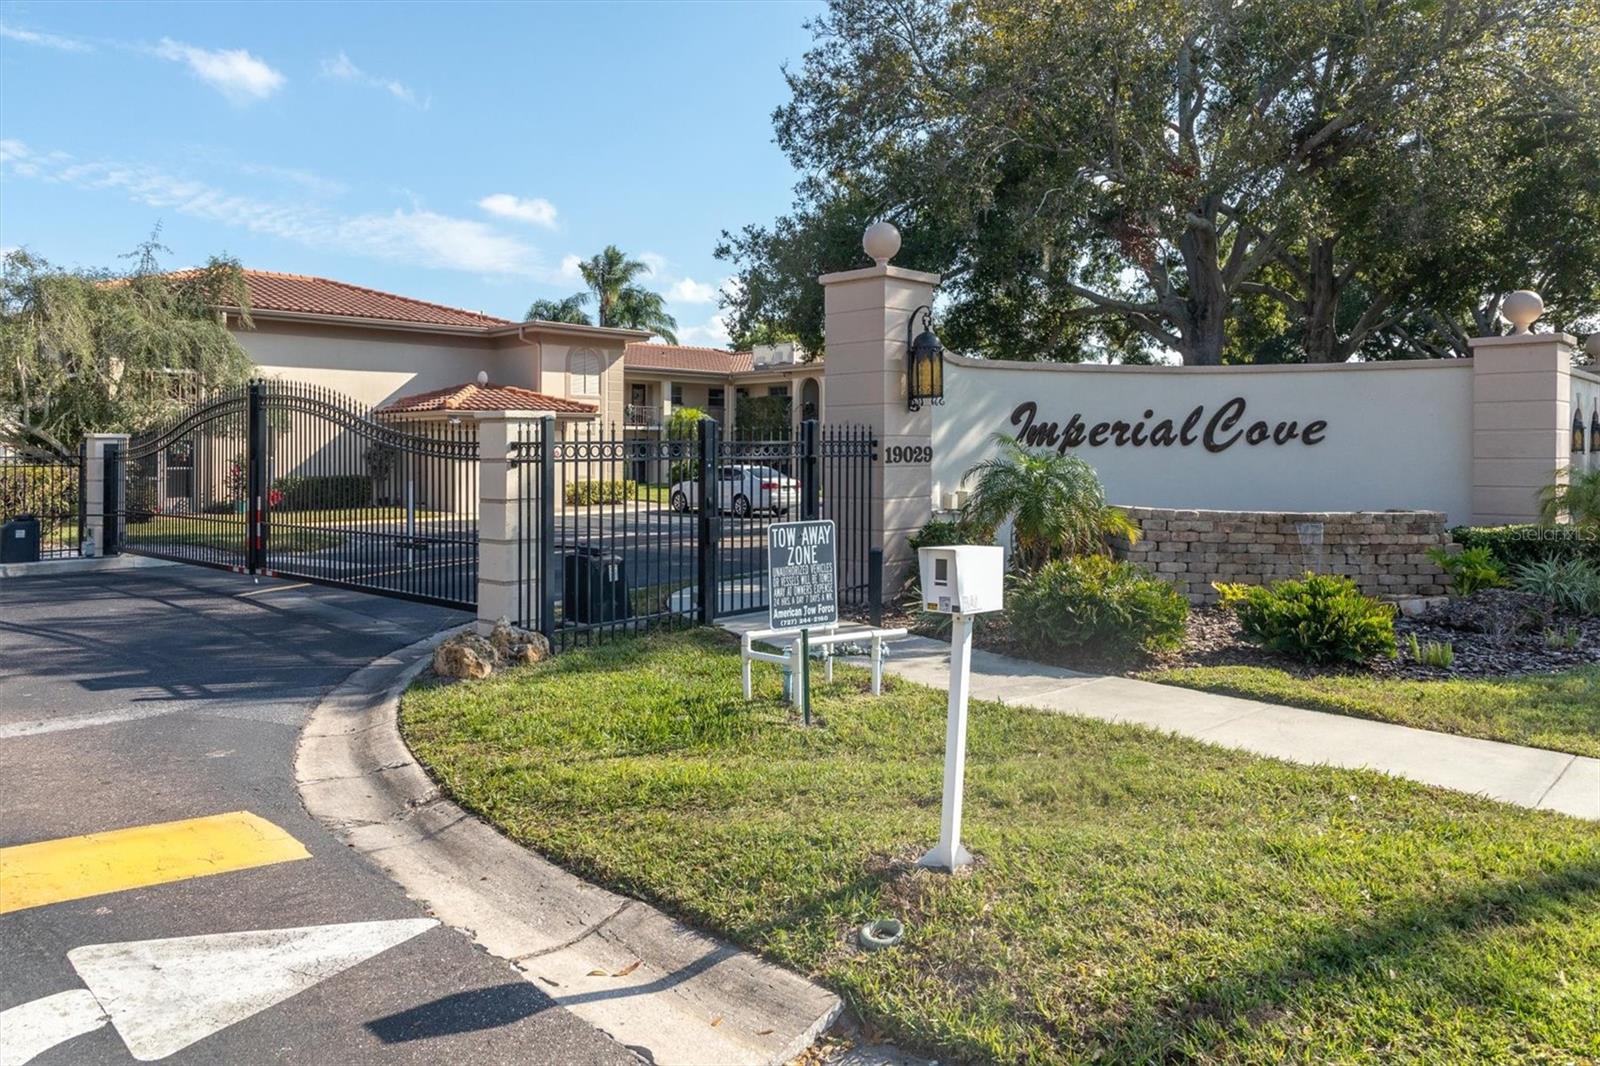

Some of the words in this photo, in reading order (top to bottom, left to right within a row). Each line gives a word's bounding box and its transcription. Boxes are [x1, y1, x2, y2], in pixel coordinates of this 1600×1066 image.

[1010, 401, 1203, 458] Imperial
[1203, 397, 1327, 453] Cove
[885, 446, 933, 464] 19029
[772, 528, 796, 548] TOW
[801, 525, 832, 546] AWAY
[787, 545, 818, 566] ZONE
[810, 562, 833, 575] VEHICLES
[800, 574, 810, 585] WILL
[813, 583, 833, 594] EXPENSE
[791, 596, 795, 604] A
[773, 608, 802, 619] American
[803, 605, 816, 616] Tow
[817, 604, 835, 614] Force
[780, 618, 797, 626] (727)
